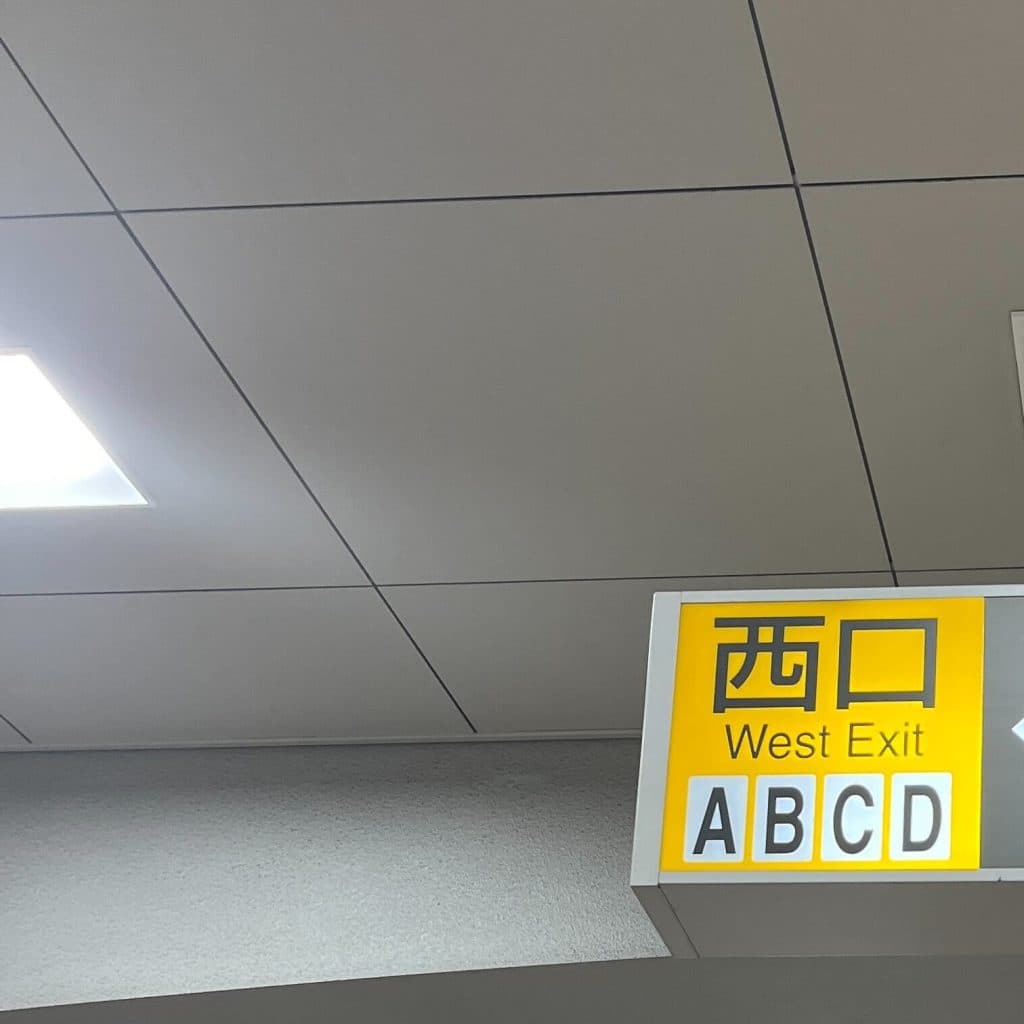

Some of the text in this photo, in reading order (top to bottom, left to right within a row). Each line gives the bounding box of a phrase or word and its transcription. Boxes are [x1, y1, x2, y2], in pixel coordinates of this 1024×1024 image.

[713, 616, 938, 713] 西口
[725, 722, 924, 760] West Exit
[692, 785, 942, 854] A B C D
